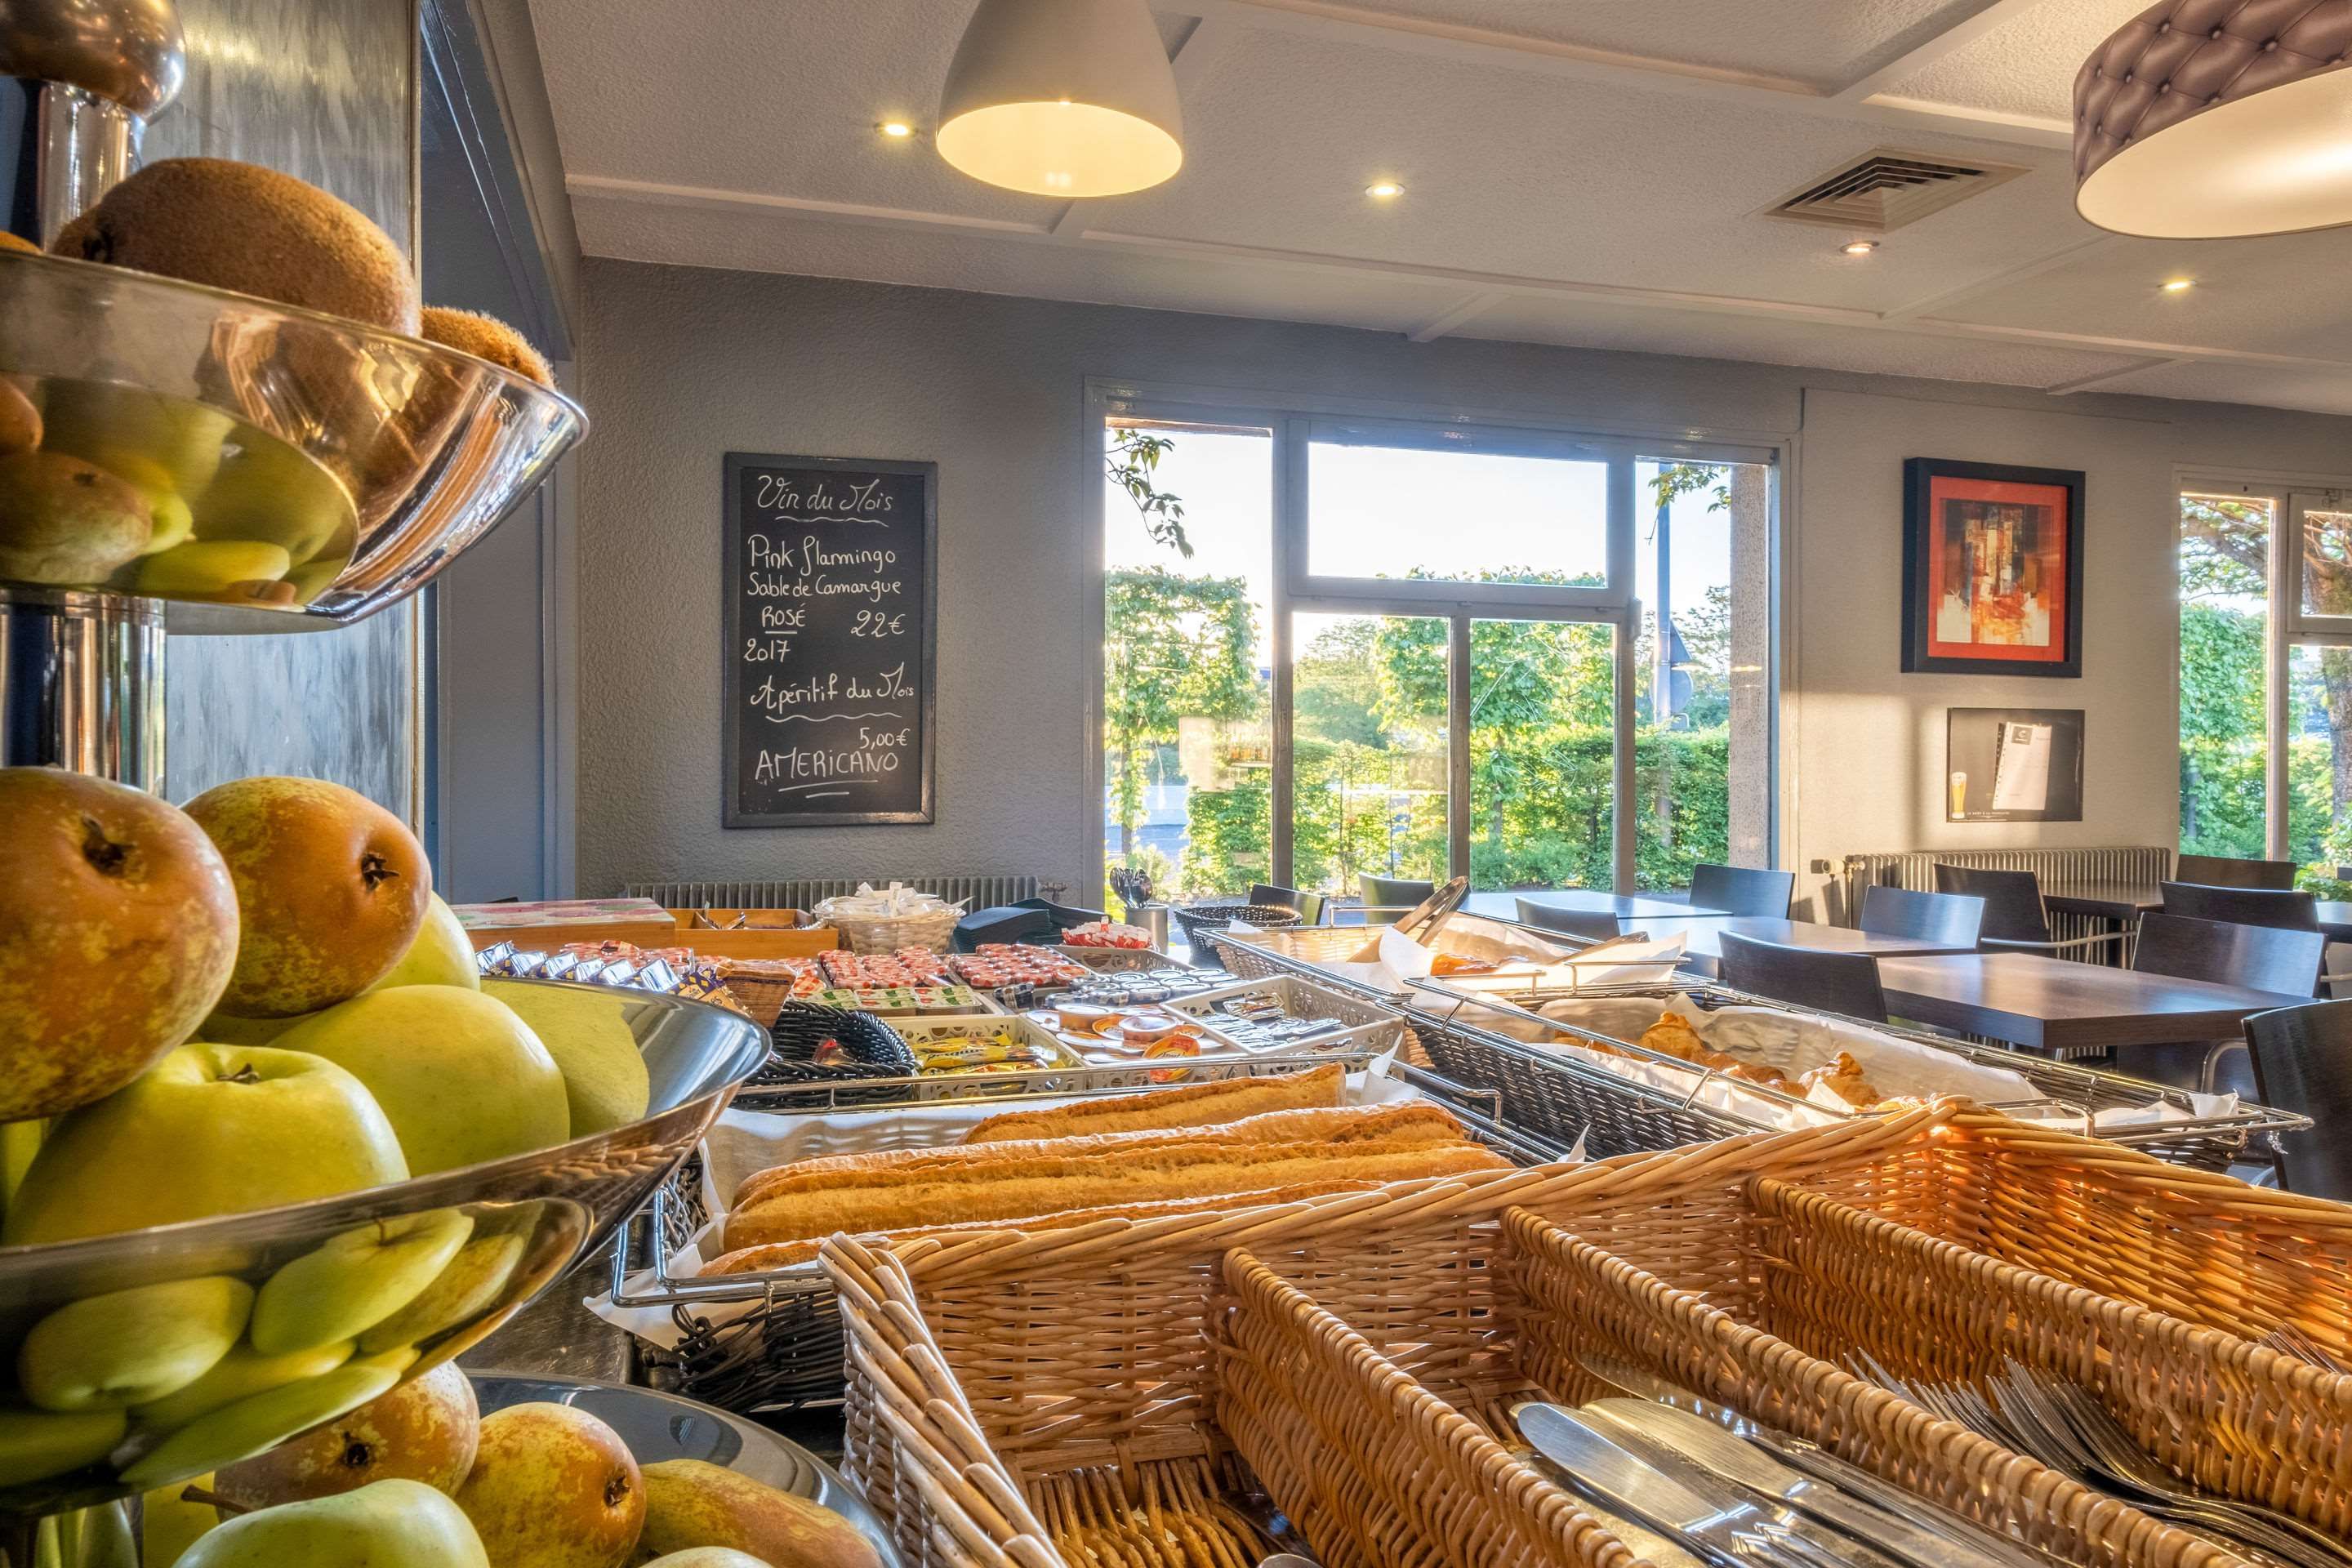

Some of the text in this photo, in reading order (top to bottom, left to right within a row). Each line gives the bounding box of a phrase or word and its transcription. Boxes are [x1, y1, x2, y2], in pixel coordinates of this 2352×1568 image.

[757, 475, 893, 512] Vin du Mois
[748, 534, 795, 569] Pink
[747, 572, 902, 602] Sable de Camargue
[850, 610, 906, 638] 22€
[743, 638, 791, 662] 2017
[751, 662, 915, 715] Apéritif du Mois
[859, 727, 911, 751] 5,00€
